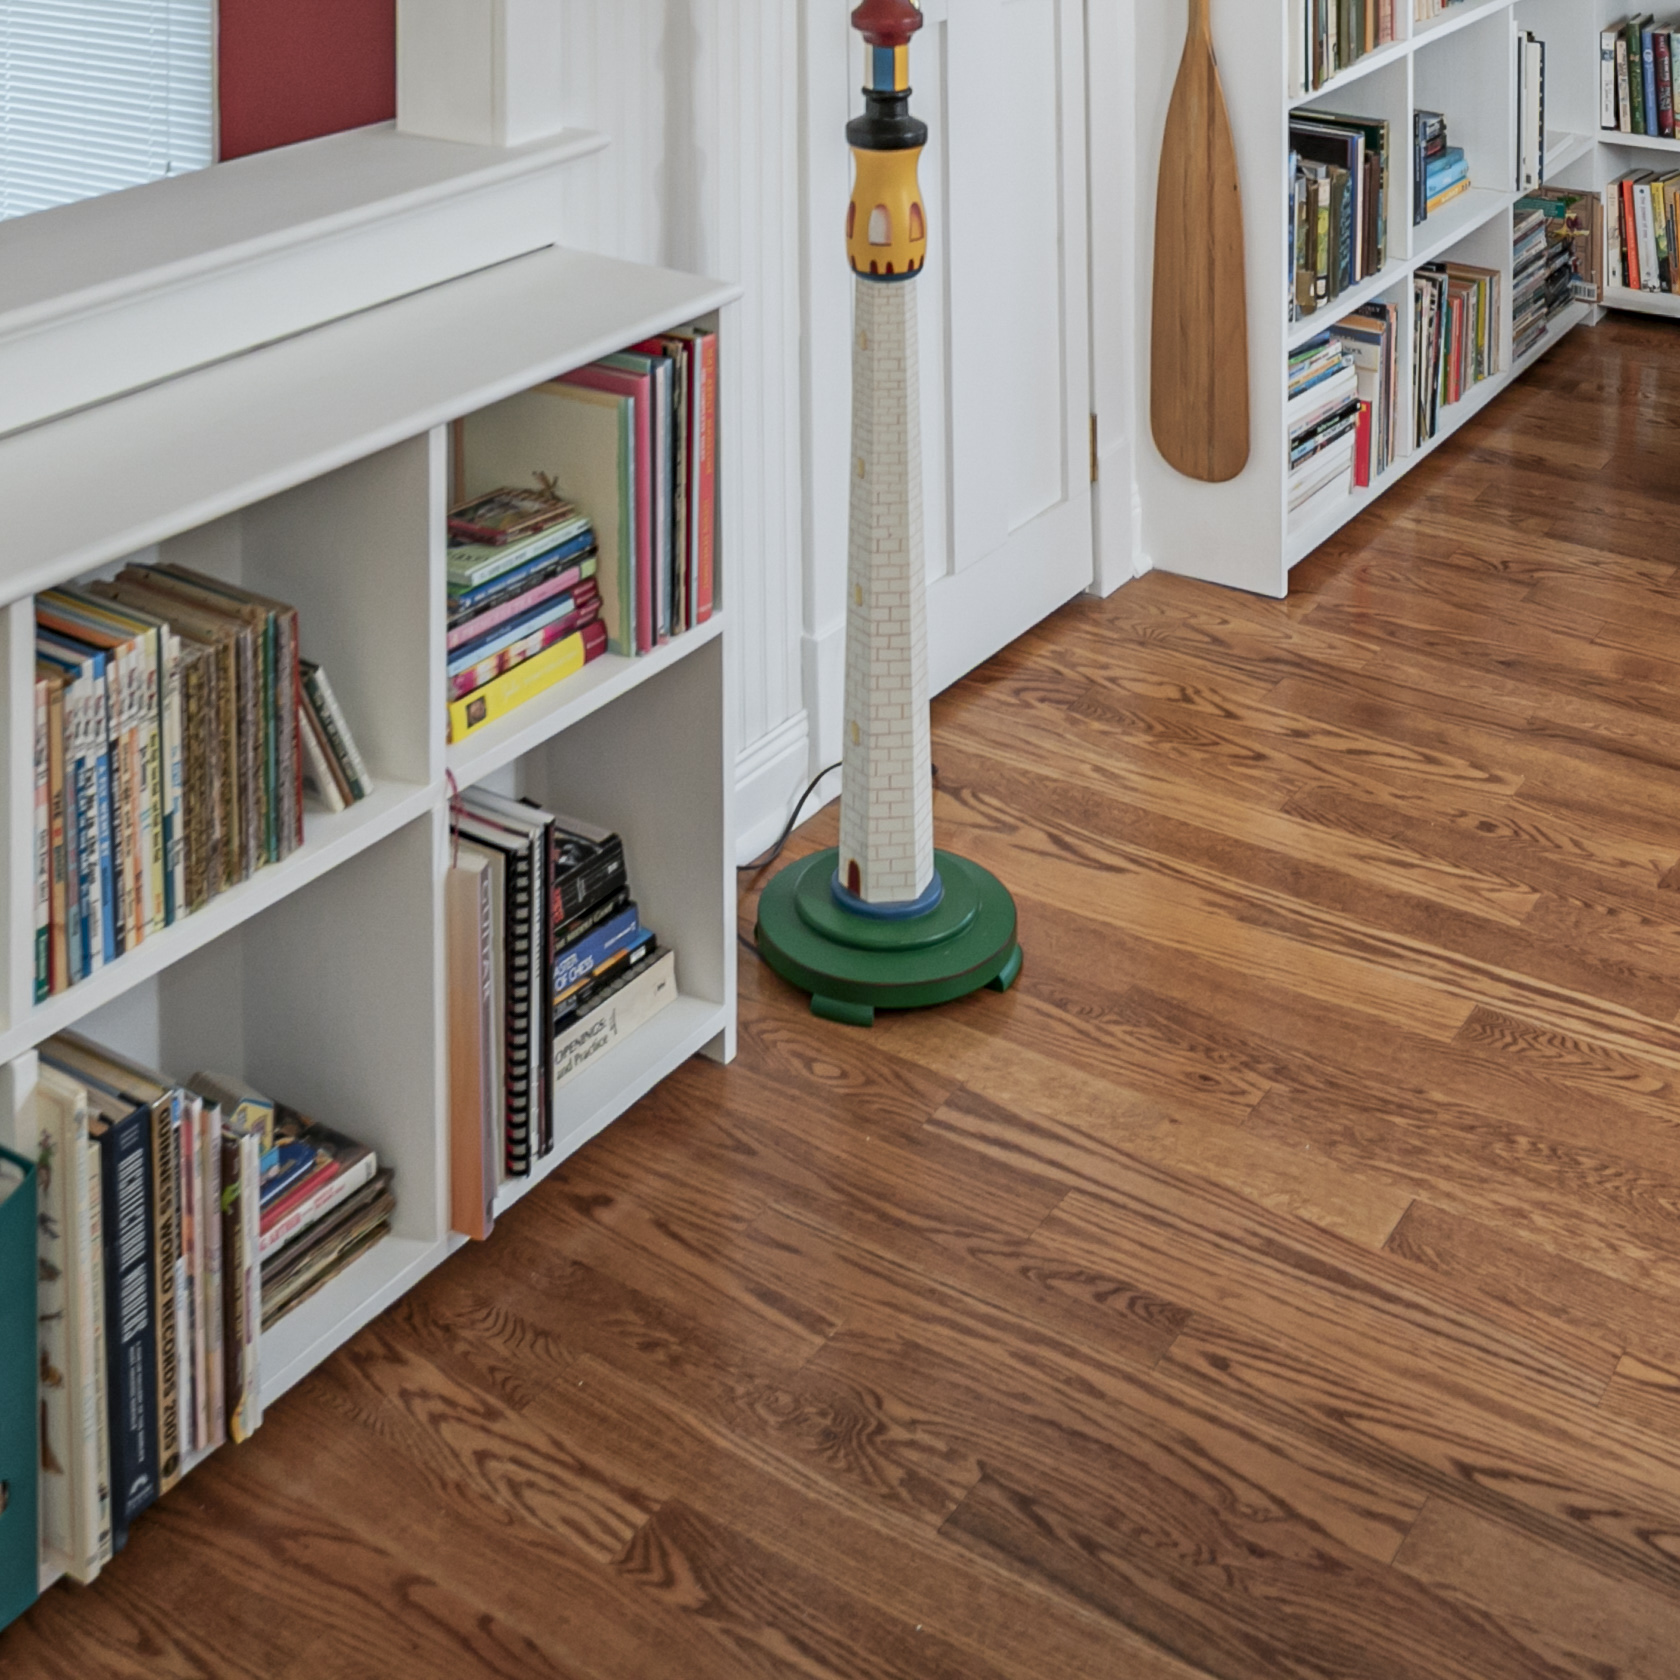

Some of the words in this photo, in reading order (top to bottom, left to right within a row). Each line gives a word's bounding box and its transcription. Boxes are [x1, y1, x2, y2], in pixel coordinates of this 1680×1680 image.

[569, 955, 594, 982] CHESS
[574, 1034, 609, 1070] Practice
[157, 1107, 174, 1217] GUINNESS
[159, 1221, 175, 1294] WORLD
[162, 1297, 176, 1398] RECORDS
[163, 1399, 178, 1451] 2005
